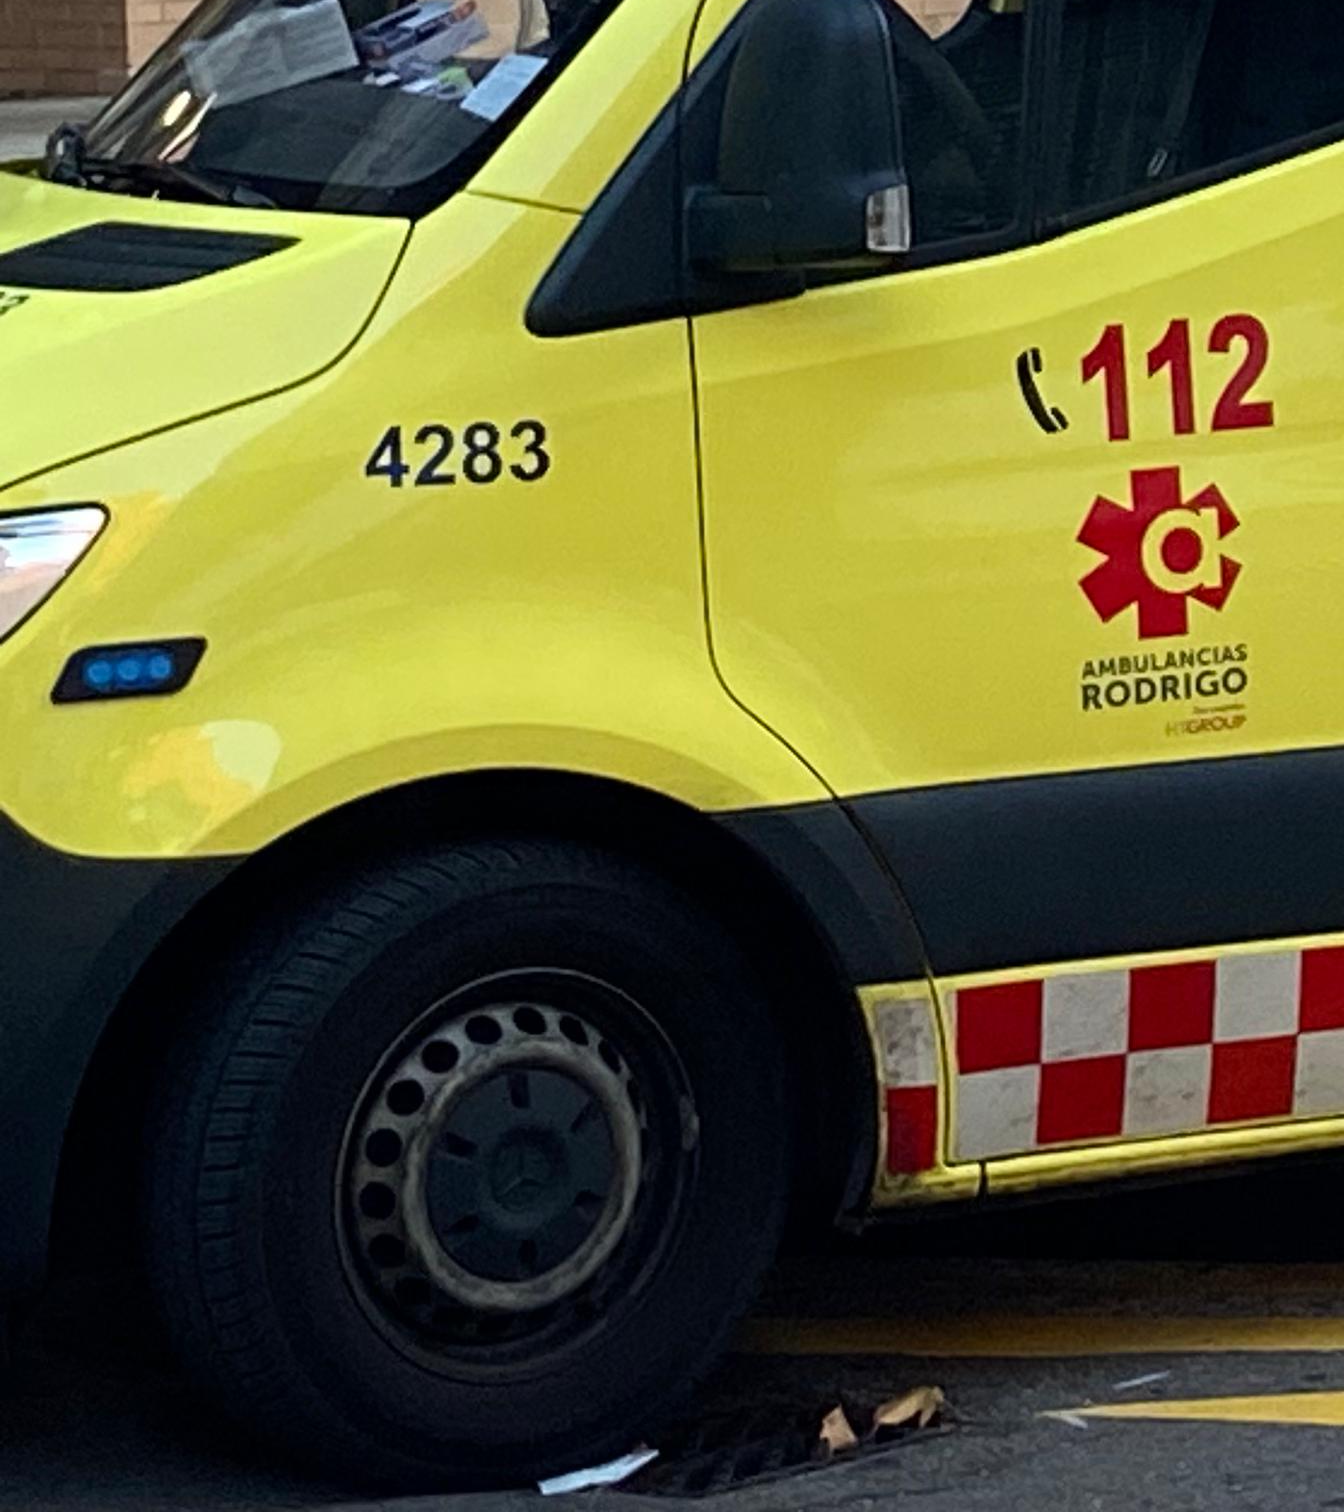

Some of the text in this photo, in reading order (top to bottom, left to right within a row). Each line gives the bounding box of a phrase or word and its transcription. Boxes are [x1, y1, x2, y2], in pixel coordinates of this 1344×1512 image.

[1080, 313, 1274, 442] 112
[365, 419, 550, 488] 4283
[1081, 667, 1248, 711] RODRIGO
[1082, 643, 1248, 680] AMBULANCIAS
